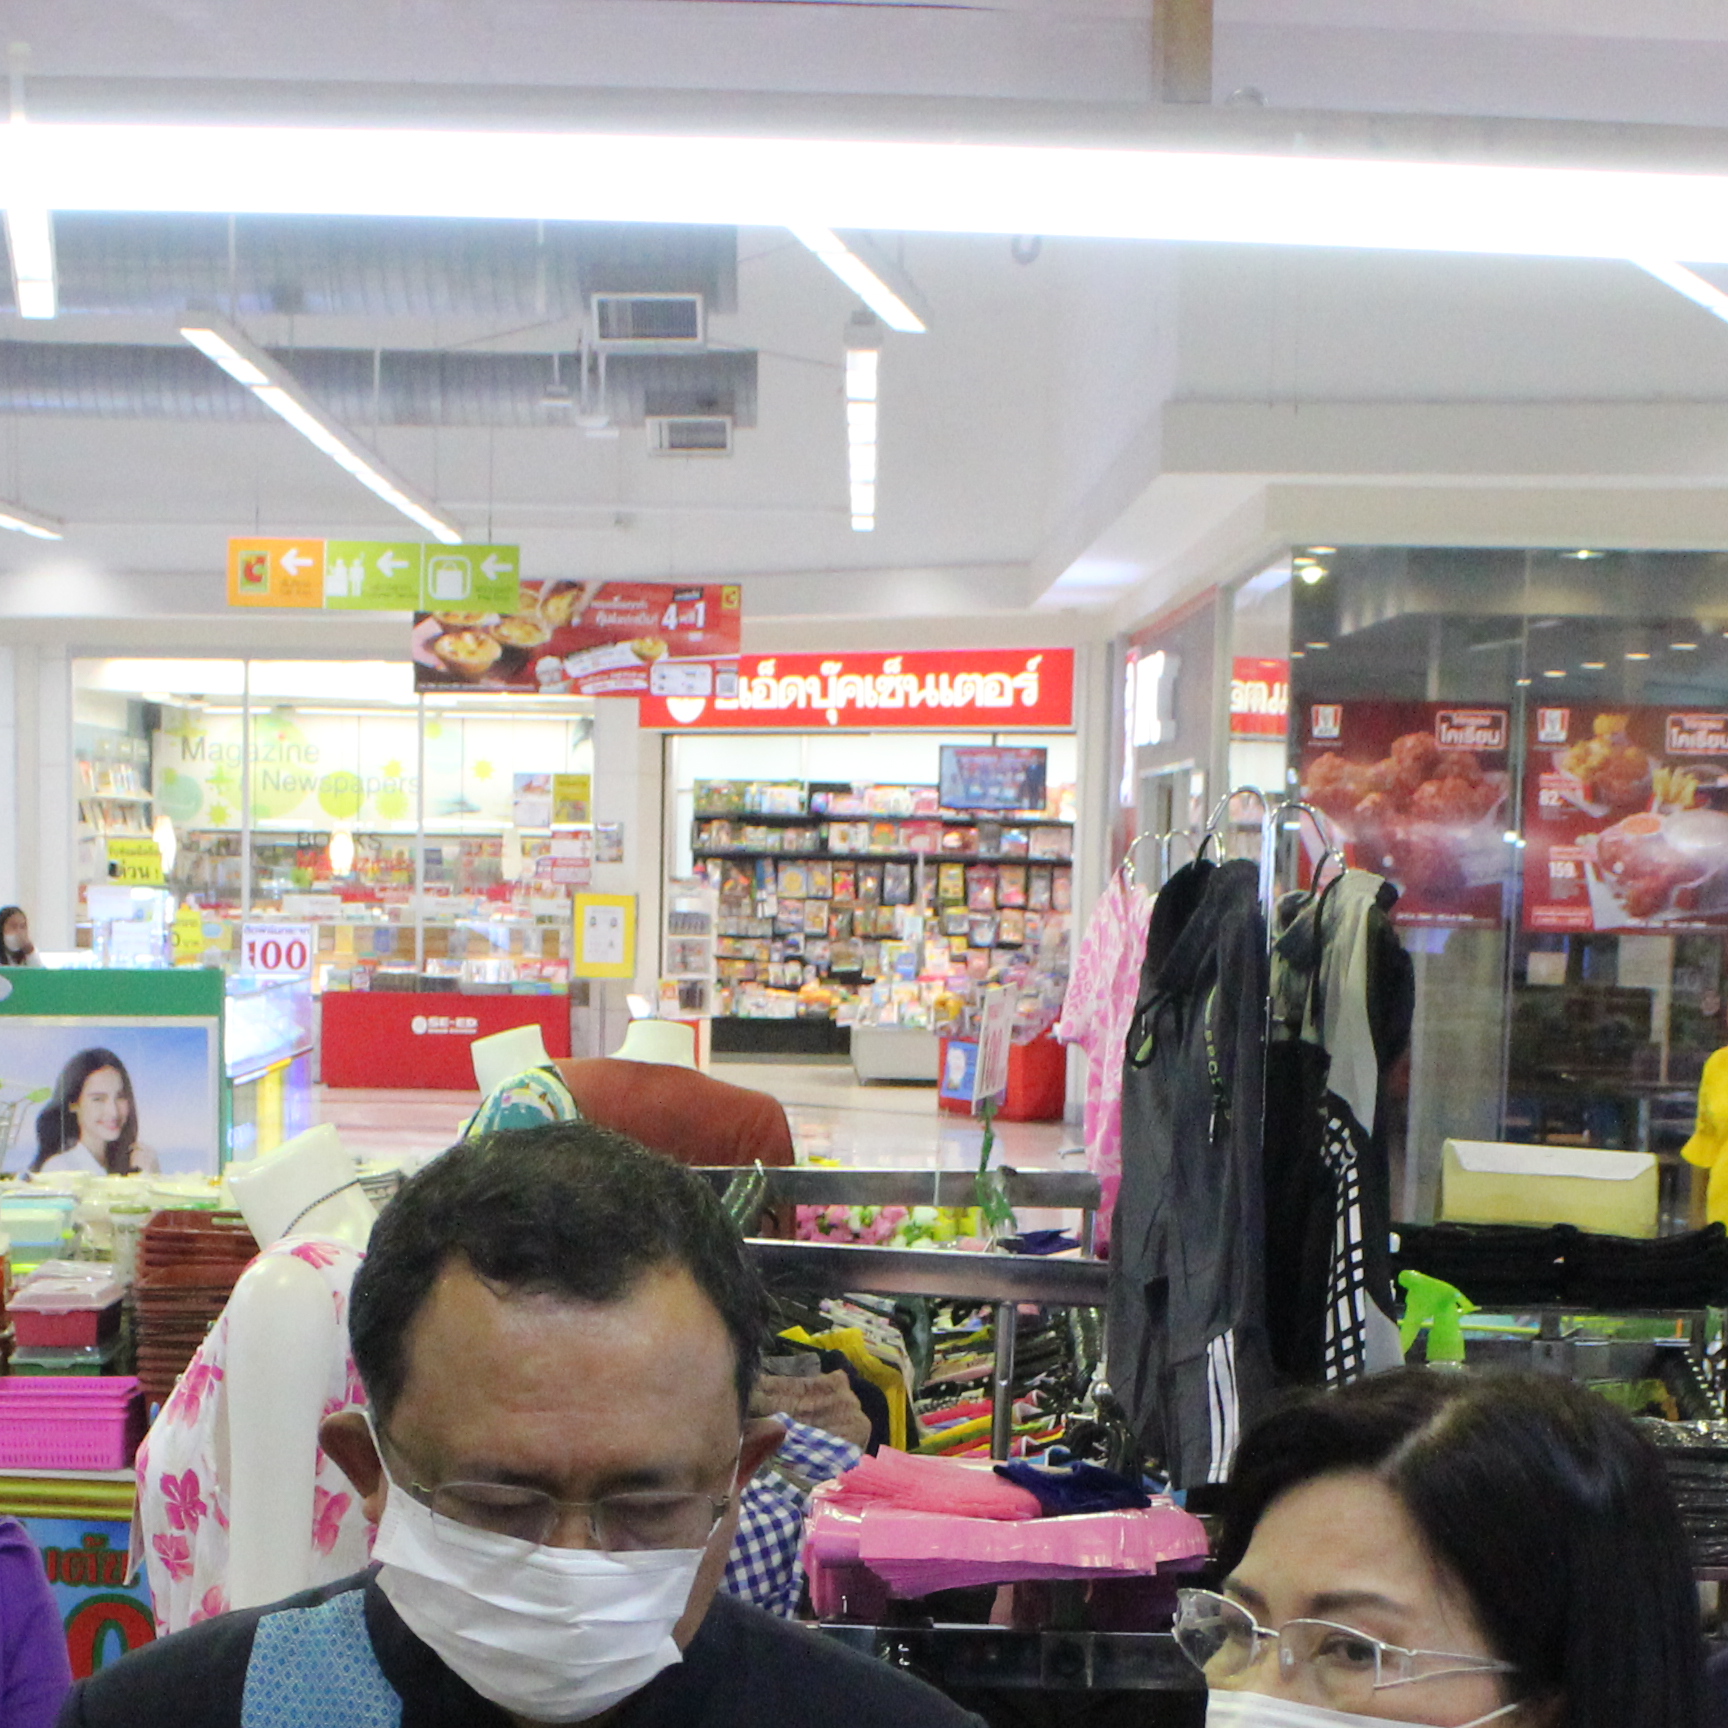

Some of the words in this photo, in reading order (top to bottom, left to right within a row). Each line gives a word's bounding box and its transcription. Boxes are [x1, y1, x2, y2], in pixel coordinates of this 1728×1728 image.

[715, 654, 1044, 726] เอ็ดบุ๊คเซ็นเตอร์
[181, 735, 320, 768] Magazine
[261, 769, 419, 798] Newspapers
[246, 939, 307, 971] 100
